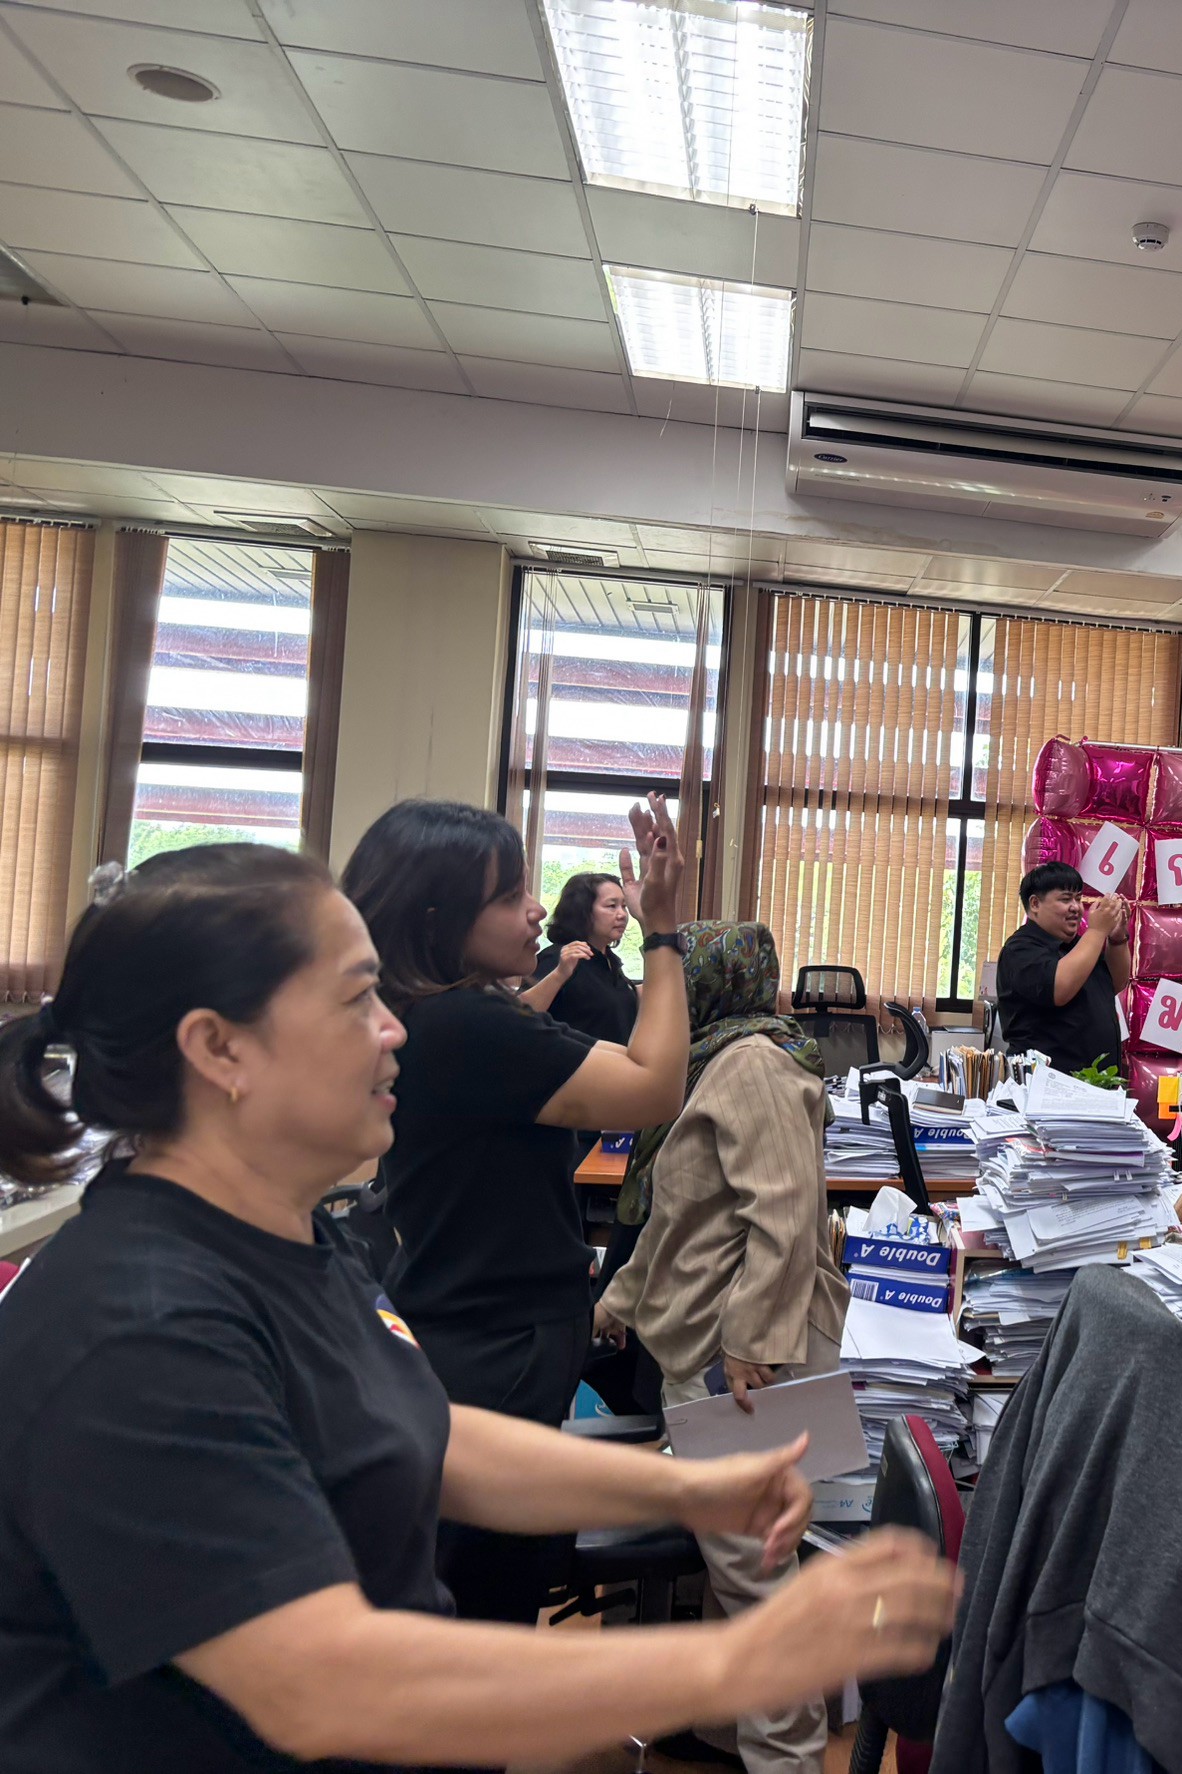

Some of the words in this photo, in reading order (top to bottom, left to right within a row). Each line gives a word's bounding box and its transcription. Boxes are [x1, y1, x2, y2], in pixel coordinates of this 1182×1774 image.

[914, 1128, 924, 1138] A
[860, 1243, 875, 1257] A
[879, 1246, 942, 1266] Double
[884, 1289, 896, 1300] A
[898, 1291, 943, 1308] Double
